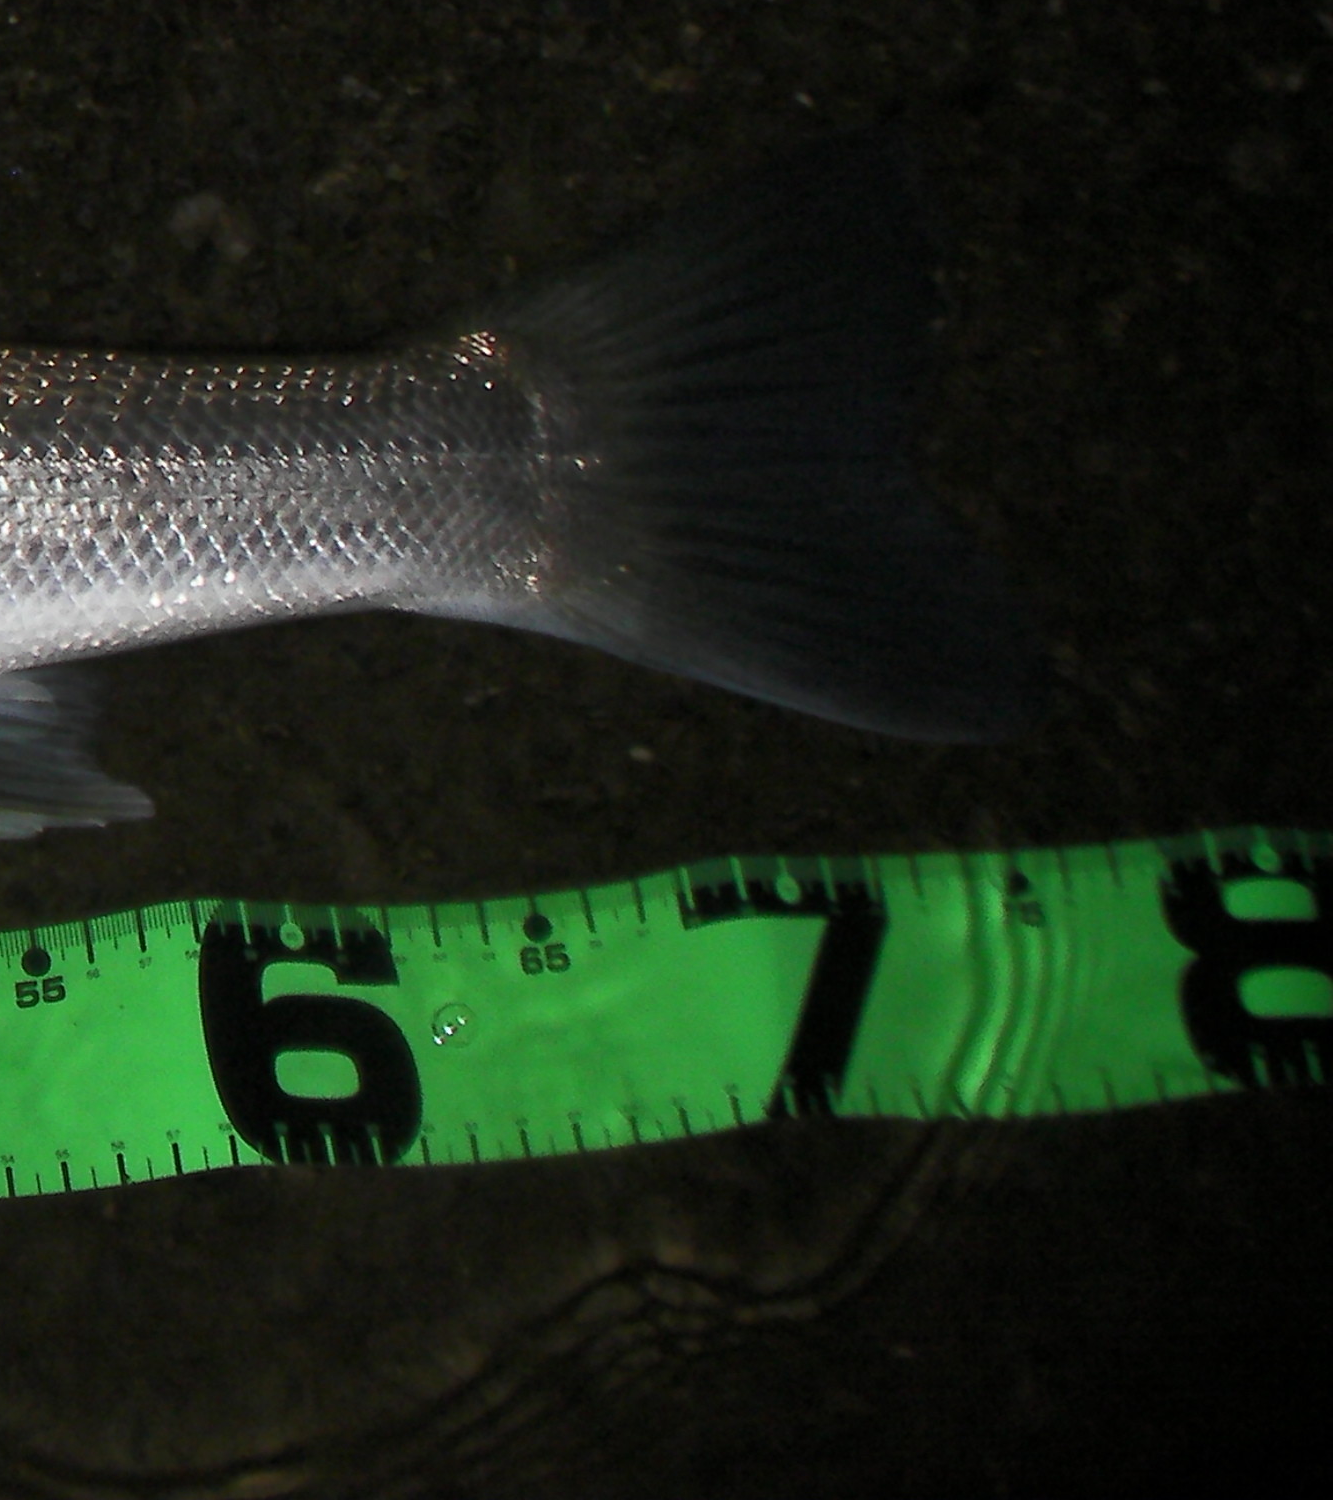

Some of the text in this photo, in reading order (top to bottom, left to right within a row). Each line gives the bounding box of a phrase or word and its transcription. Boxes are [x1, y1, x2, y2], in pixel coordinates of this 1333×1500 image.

[14, 975, 67, 1010] 55
[200, 903, 422, 1166] 6
[519, 943, 571, 977] 65
[677, 857, 889, 1117] 7
[1157, 833, 1333, 1098] 8
